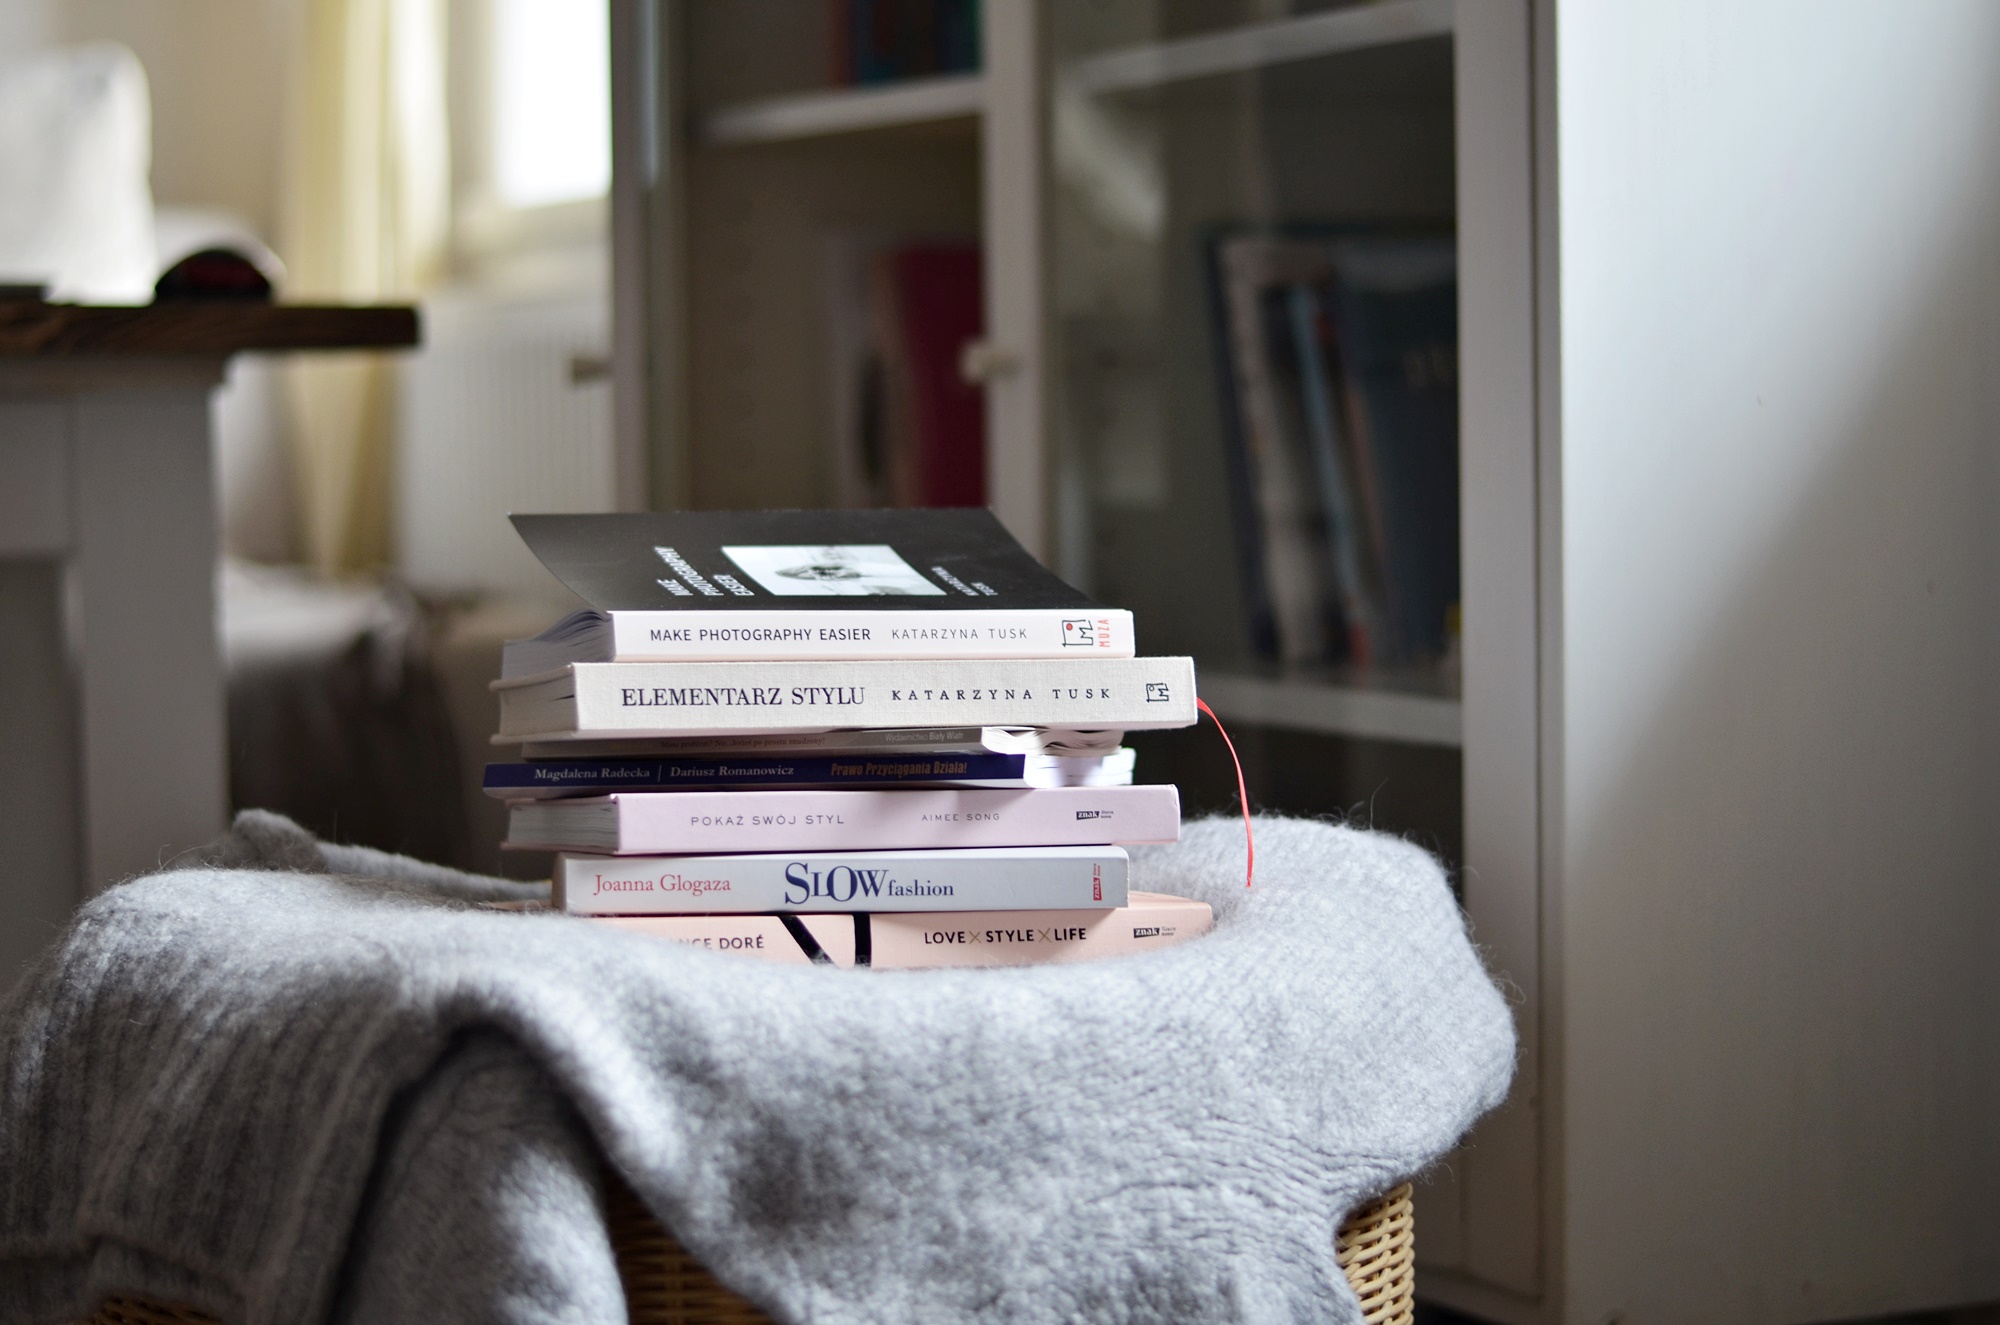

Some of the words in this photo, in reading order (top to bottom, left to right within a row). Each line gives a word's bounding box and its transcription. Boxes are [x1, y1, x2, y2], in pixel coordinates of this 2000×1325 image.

[650, 629, 692, 641] MAKE
[699, 628, 812, 641] PHOTOGRAPHY
[819, 628, 871, 641] EASIER
[891, 628, 979, 640] KATARZYNA
[989, 628, 1028, 639] TUSK
[1097, 619, 1110, 648] MUZA
[621, 687, 783, 707] ELEMENTARZ
[791, 686, 865, 706] STYLU
[891, 689, 1032, 701] KATARZYNA
[1052, 688, 1110, 700] TUSK
[534, 768, 598, 781] Magdalena
[601, 767, 650, 778] Radecka
[670, 766, 715, 778] Dariusz
[719, 764, 795, 776] Romanowicz
[831, 763, 863, 776] Prawo
[866, 762, 931, 778] Przyciągania
[691, 813, 745, 827] POKAŻ
[752, 813, 797, 826] SWÓJ
[805, 814, 845, 825] STYL
[921, 813, 959, 822] AIMEE
[966, 812, 1001, 822] SONG
[593, 874, 654, 896] Joanna
[660, 874, 732, 896] Glogaza
[784, 863, 889, 905] SLOW
[887, 879, 955, 897] fashion
[924, 930, 966, 945] LOVE
[985, 928, 1035, 943] STYLE
[1054, 926, 1087, 941] LIFE
[1134, 927, 1160, 938] znak
[719, 934, 765, 950] DORÉ
